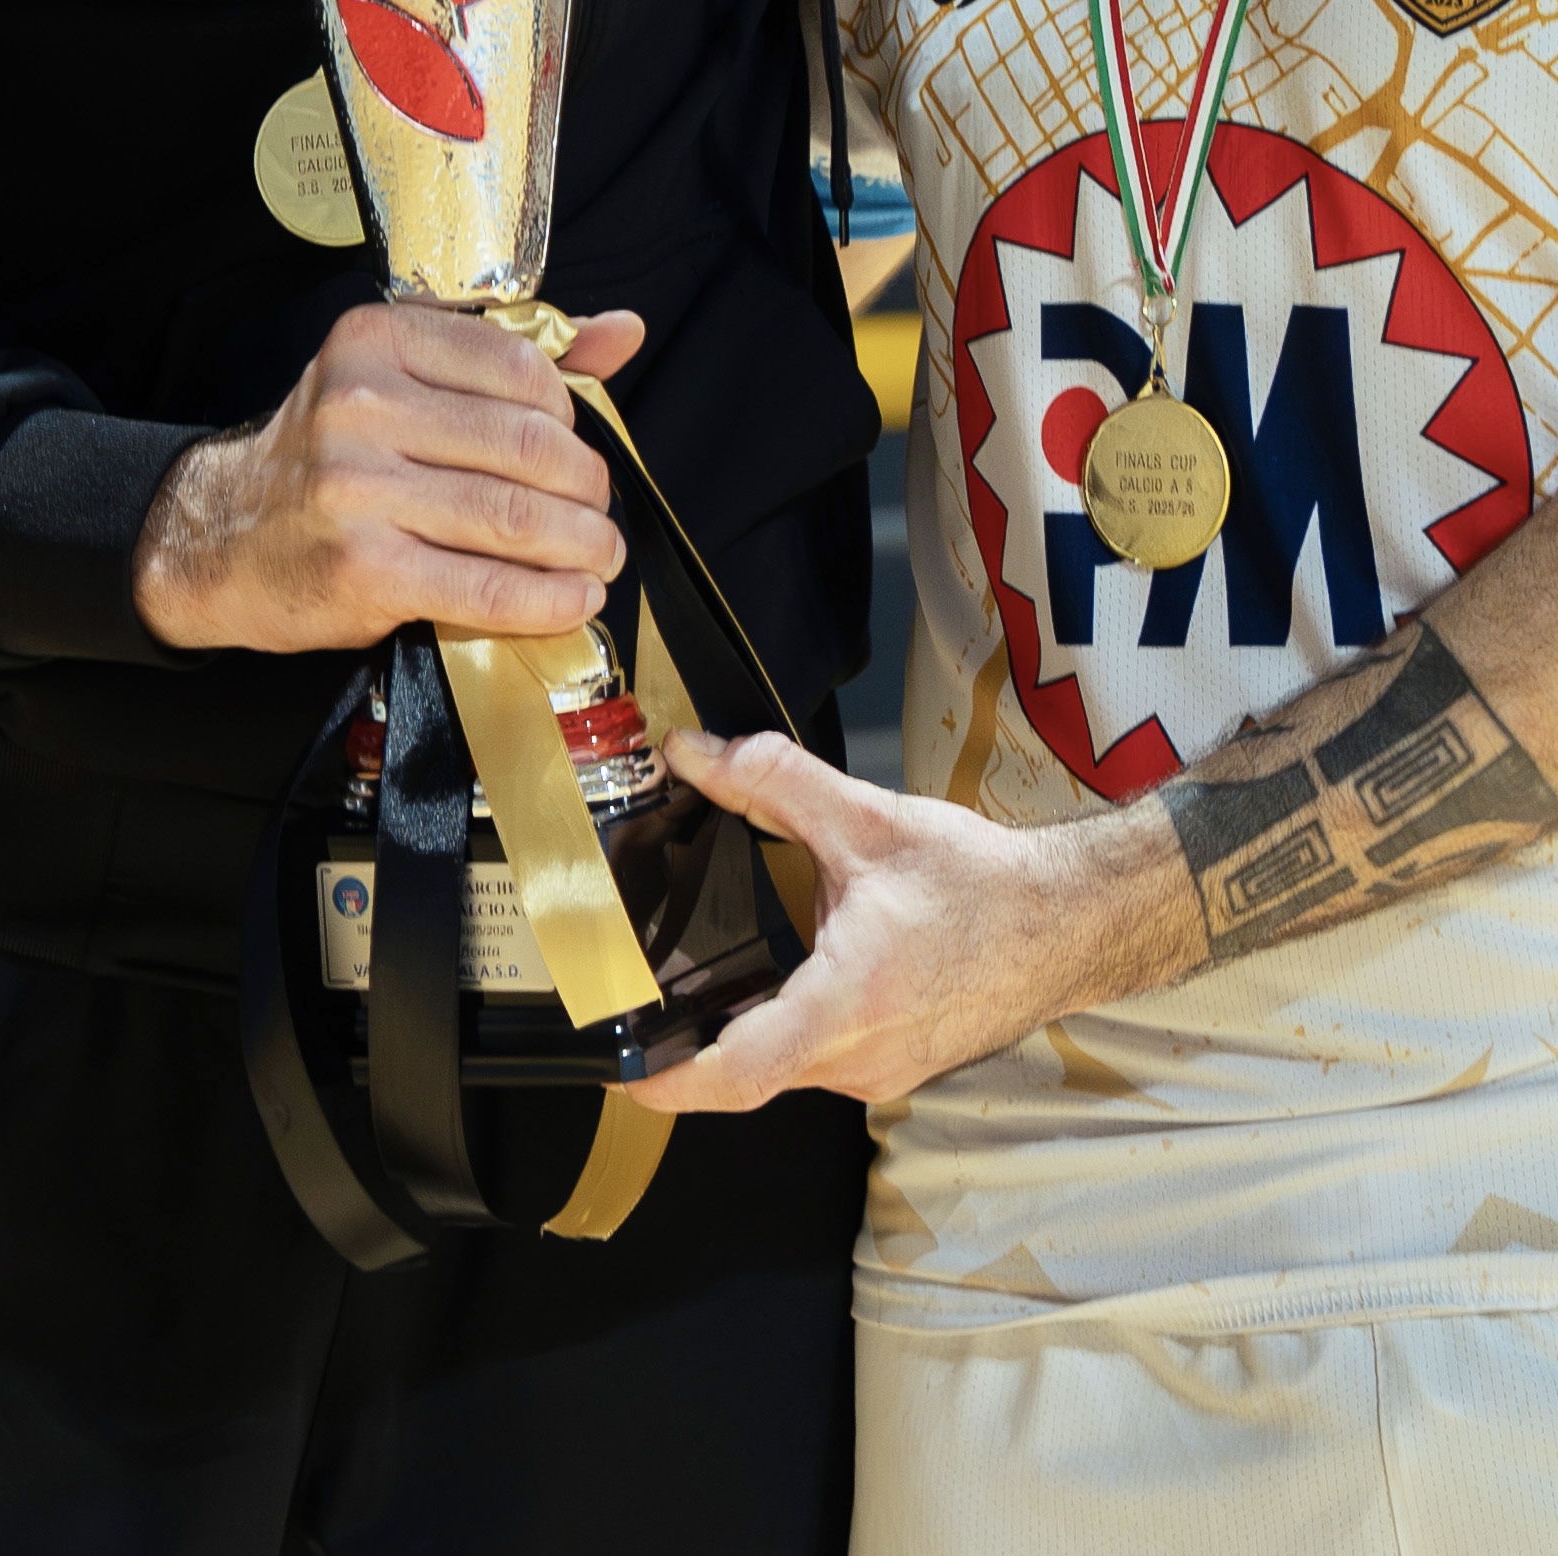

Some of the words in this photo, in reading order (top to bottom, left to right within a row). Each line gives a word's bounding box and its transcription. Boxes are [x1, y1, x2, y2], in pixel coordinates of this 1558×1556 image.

[1115, 450, 1162, 470] FINALS
[1170, 454, 1197, 471] CUP
[1119, 475, 1163, 494] CALCIO
[1170, 478, 1179, 494] A
[464, 880, 518, 897] ARCHE
